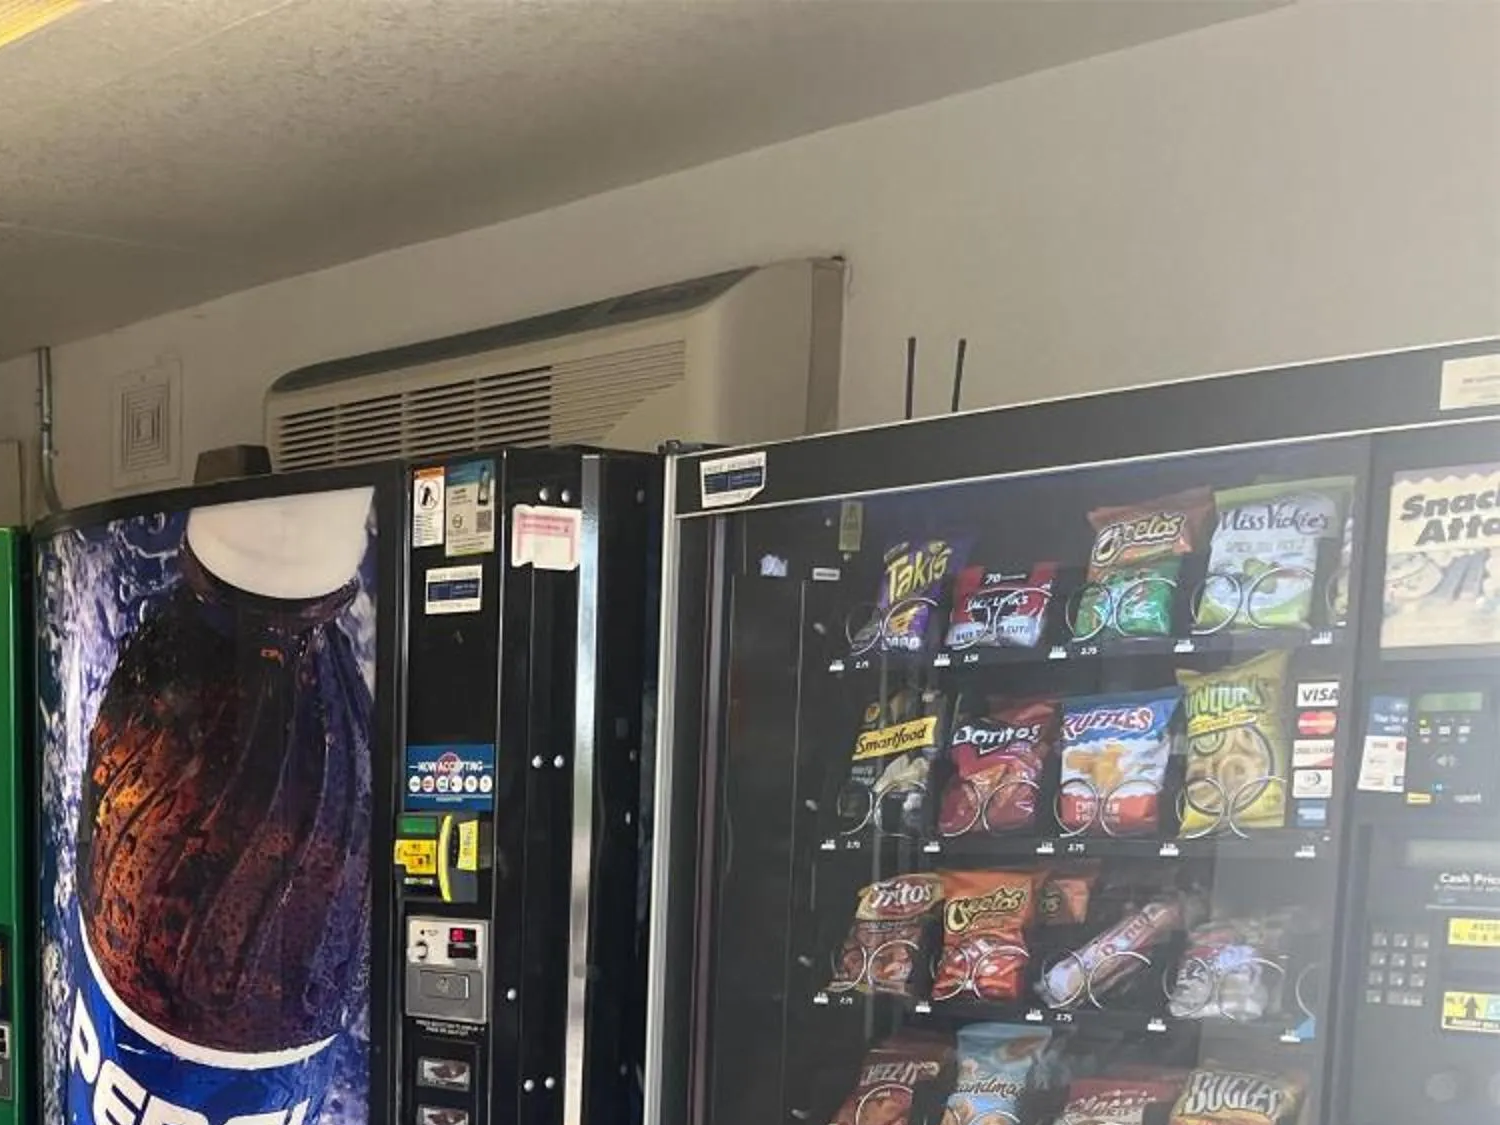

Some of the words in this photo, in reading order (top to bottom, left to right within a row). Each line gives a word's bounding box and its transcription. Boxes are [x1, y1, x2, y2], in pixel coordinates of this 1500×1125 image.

[1400, 487, 1500, 521] Snac
[884, 547, 952, 604] Takis
[1302, 686, 1339, 701] VISA
[857, 723, 929, 753] Smartfood
[953, 723, 1041, 746] Doritos
[871, 881, 932, 908] Fritos
[1184, 1071, 1282, 1121] BUGLES
